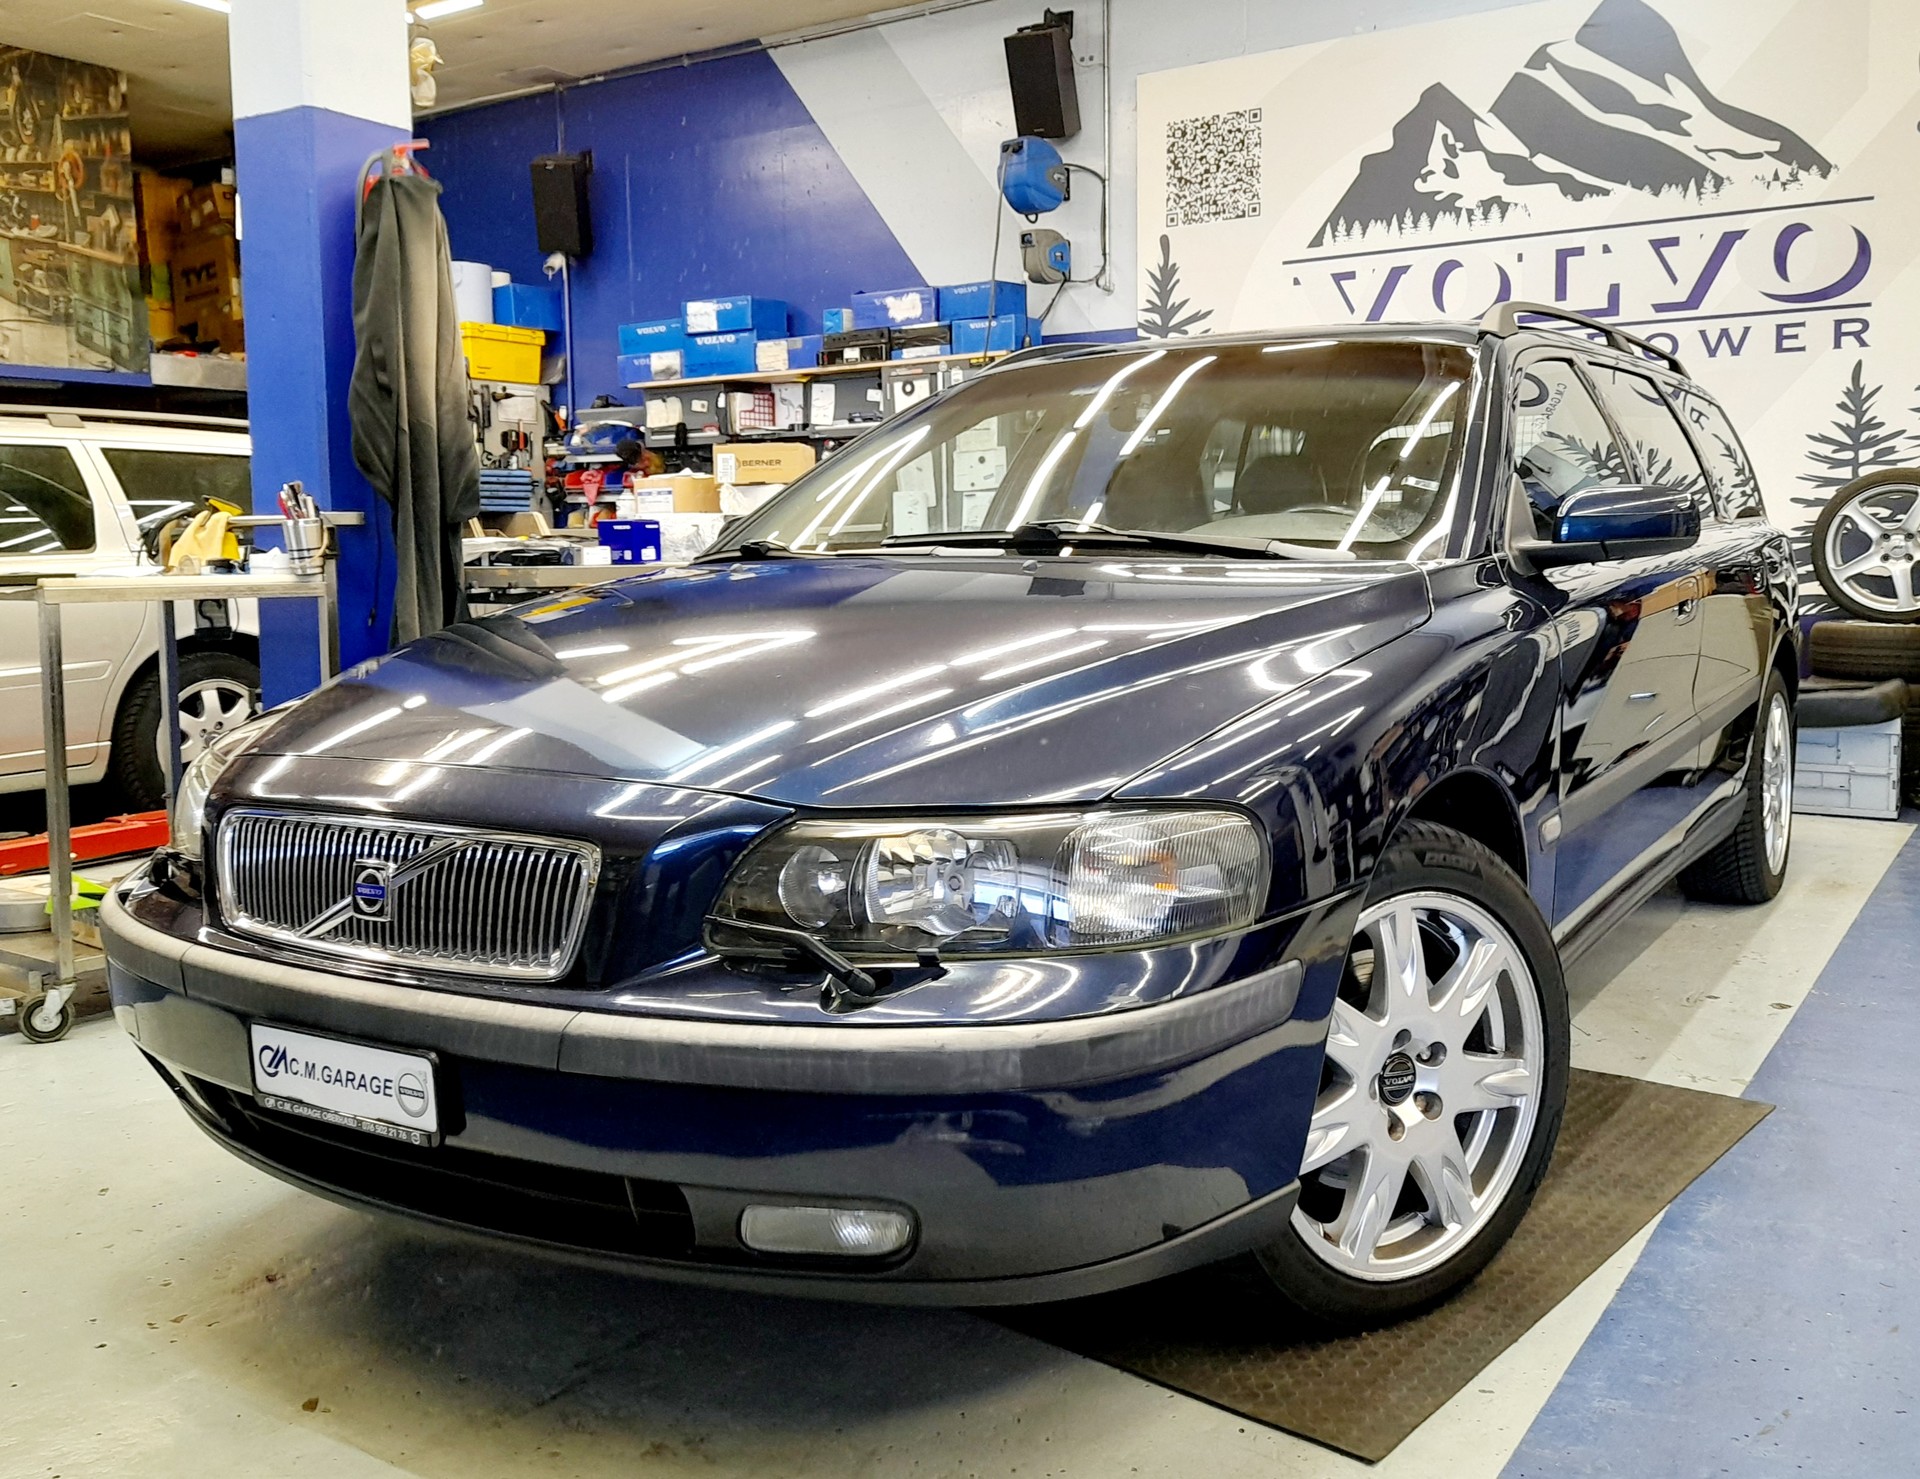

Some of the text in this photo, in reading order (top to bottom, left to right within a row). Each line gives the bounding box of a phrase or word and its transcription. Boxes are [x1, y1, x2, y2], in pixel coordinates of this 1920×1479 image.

[1288, 211, 1872, 324] VOLVO
[636, 325, 666, 335] VOLVO
[695, 334, 736, 345] VOLVO
[742, 459, 782, 467] BERNER
[356, 886, 383, 895] VOLVO
[1384, 1075, 1415, 1086] VOLVO
[292, 1104, 322, 1119] GARAGE
